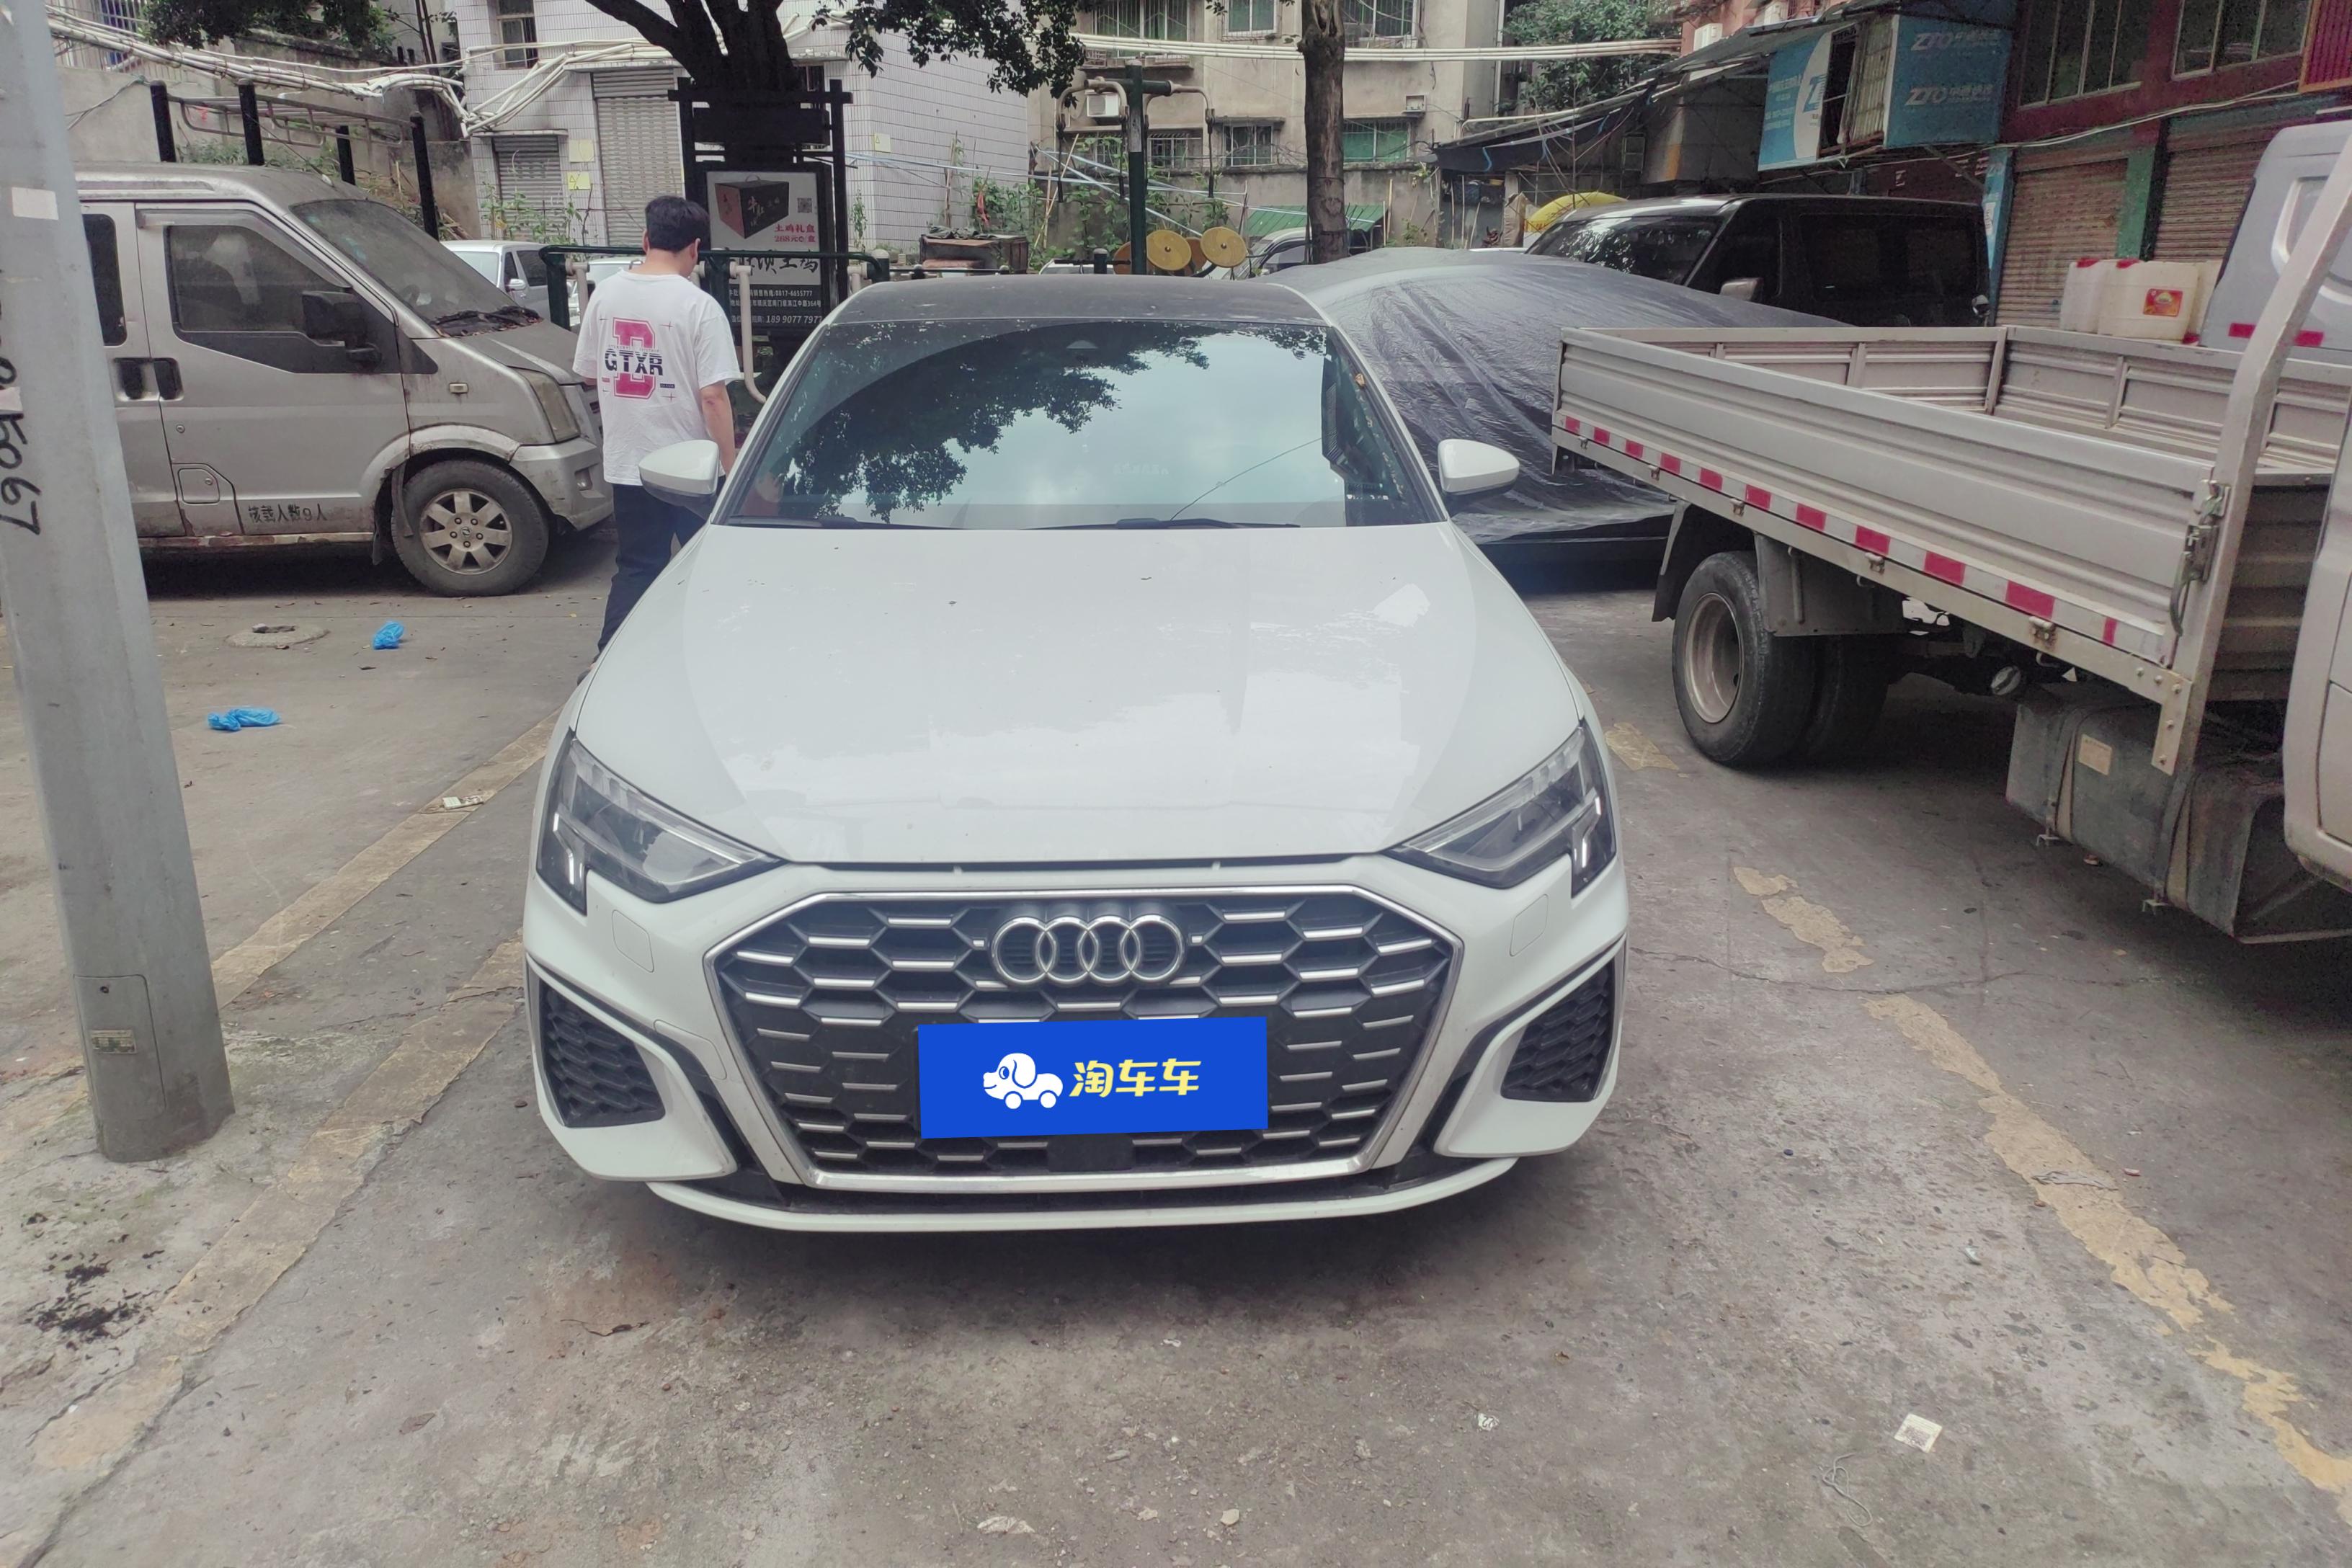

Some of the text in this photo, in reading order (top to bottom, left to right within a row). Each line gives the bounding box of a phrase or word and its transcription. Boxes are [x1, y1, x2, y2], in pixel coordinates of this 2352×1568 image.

[775, 223, 816, 233] 土鸡礼盒
[605, 348, 664, 376] GTXR
